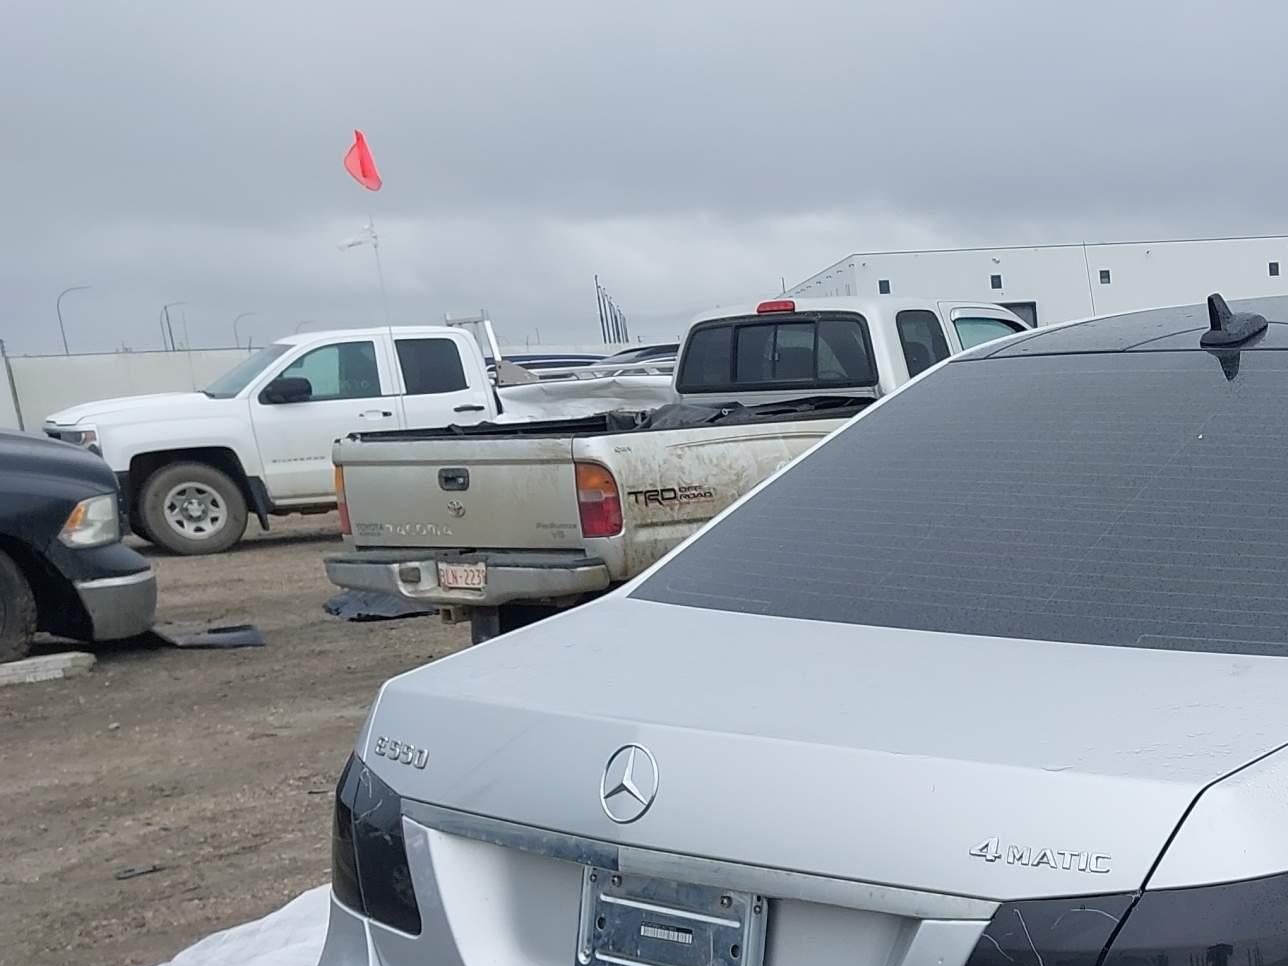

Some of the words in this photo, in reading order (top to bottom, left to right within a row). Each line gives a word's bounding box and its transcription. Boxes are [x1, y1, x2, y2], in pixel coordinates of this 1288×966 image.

[678, 485, 703, 493] OFF
[679, 491, 713, 500] ROAD
[627, 487, 677, 507] TRD
[969, 836, 1112, 873] 4MATIC
